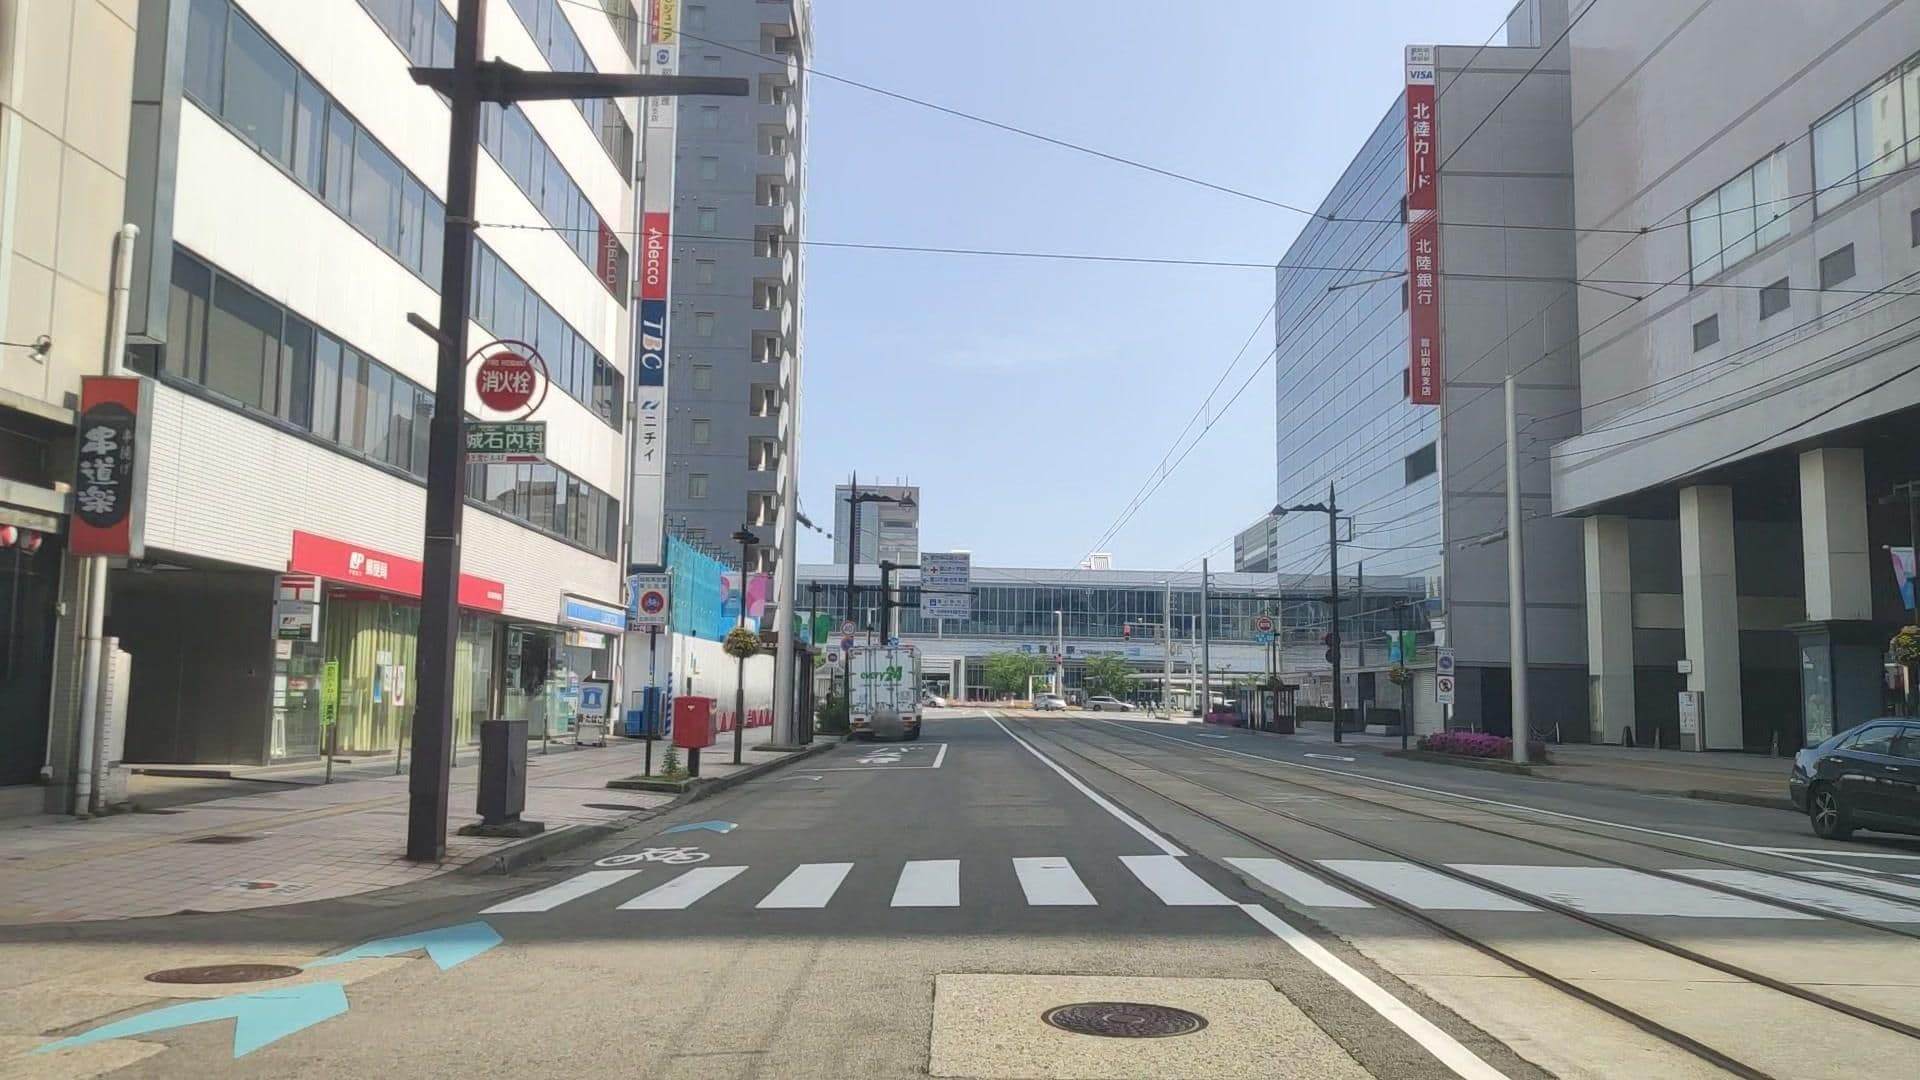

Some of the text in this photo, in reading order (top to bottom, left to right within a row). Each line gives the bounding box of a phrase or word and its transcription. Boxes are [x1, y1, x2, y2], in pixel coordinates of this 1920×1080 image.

[1410, 71, 1433, 79] VISA
[1412, 103, 1431, 189] 北陸カード
[647, 227, 663, 285] Adecco
[1415, 238, 1432, 305] 北陸銀行
[642, 317, 664, 370] TBC
[1420, 338, 1431, 396] 富山駅前支店
[481, 370, 531, 394] 消火栓
[643, 415, 657, 462] ニチイ
[77, 425, 119, 514] 串道楽
